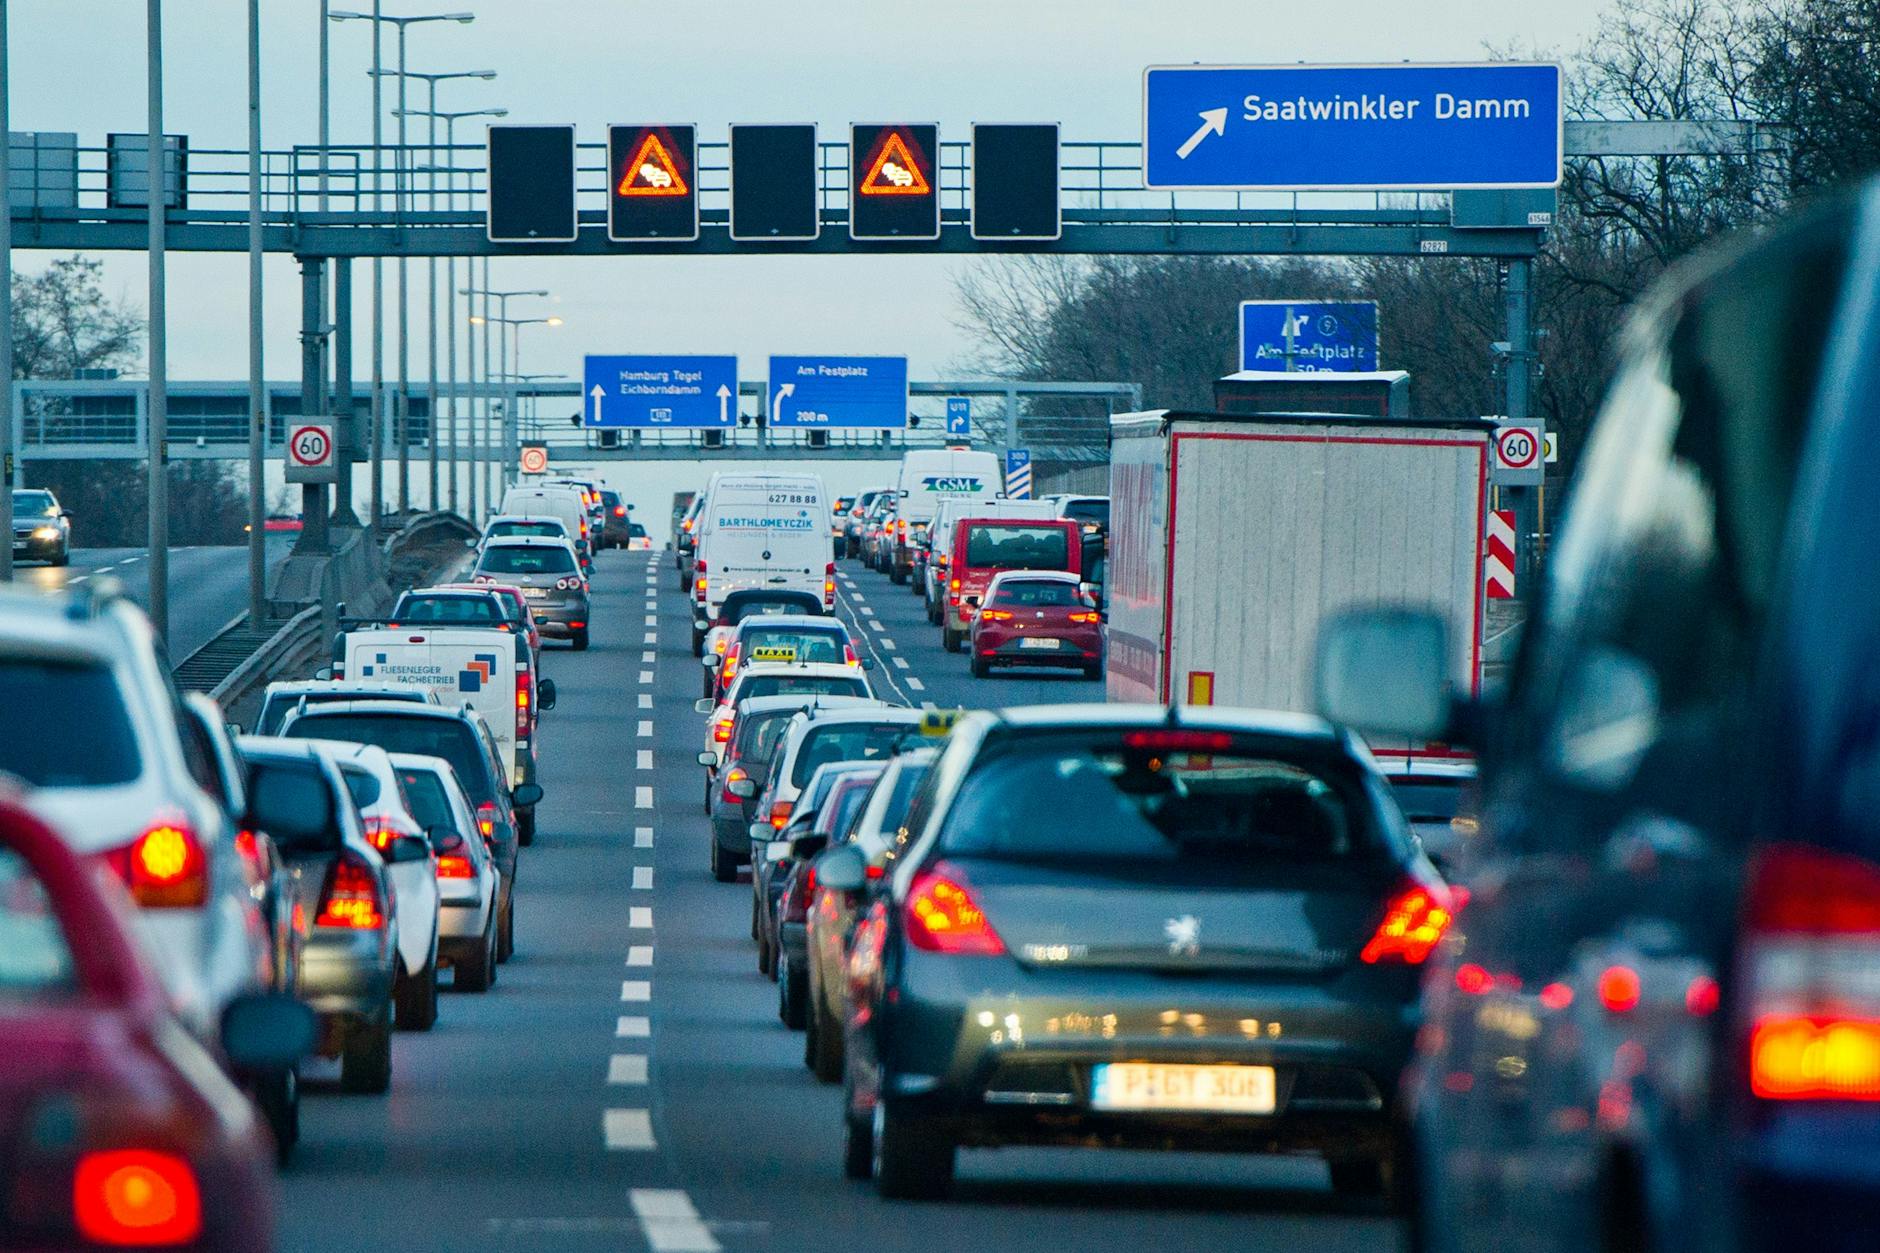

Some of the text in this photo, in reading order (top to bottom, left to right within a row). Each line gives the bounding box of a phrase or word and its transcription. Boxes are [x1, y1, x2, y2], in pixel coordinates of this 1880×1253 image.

[1243, 92, 1530, 121] Saatwinkler Damm
[1422, 241, 1446, 252] 62821
[619, 370, 702, 383] Hamburg Tegel
[796, 365, 869, 378] Am Festplatz
[620, 384, 701, 395] Eichborndamm
[796, 410, 829, 423] 200 m
[300, 437, 322, 455] 60
[1506, 438, 1529, 457] 60
[934, 478, 971, 491] GSM
[768, 494, 817, 504] 627 88 88
[719, 517, 813, 529] BARTHLOMEYCZIK
[756, 648, 793, 656] TAXI
[380, 666, 442, 675] FLIESENLEGER
[397, 675, 455, 685] FACHBETRIEB
